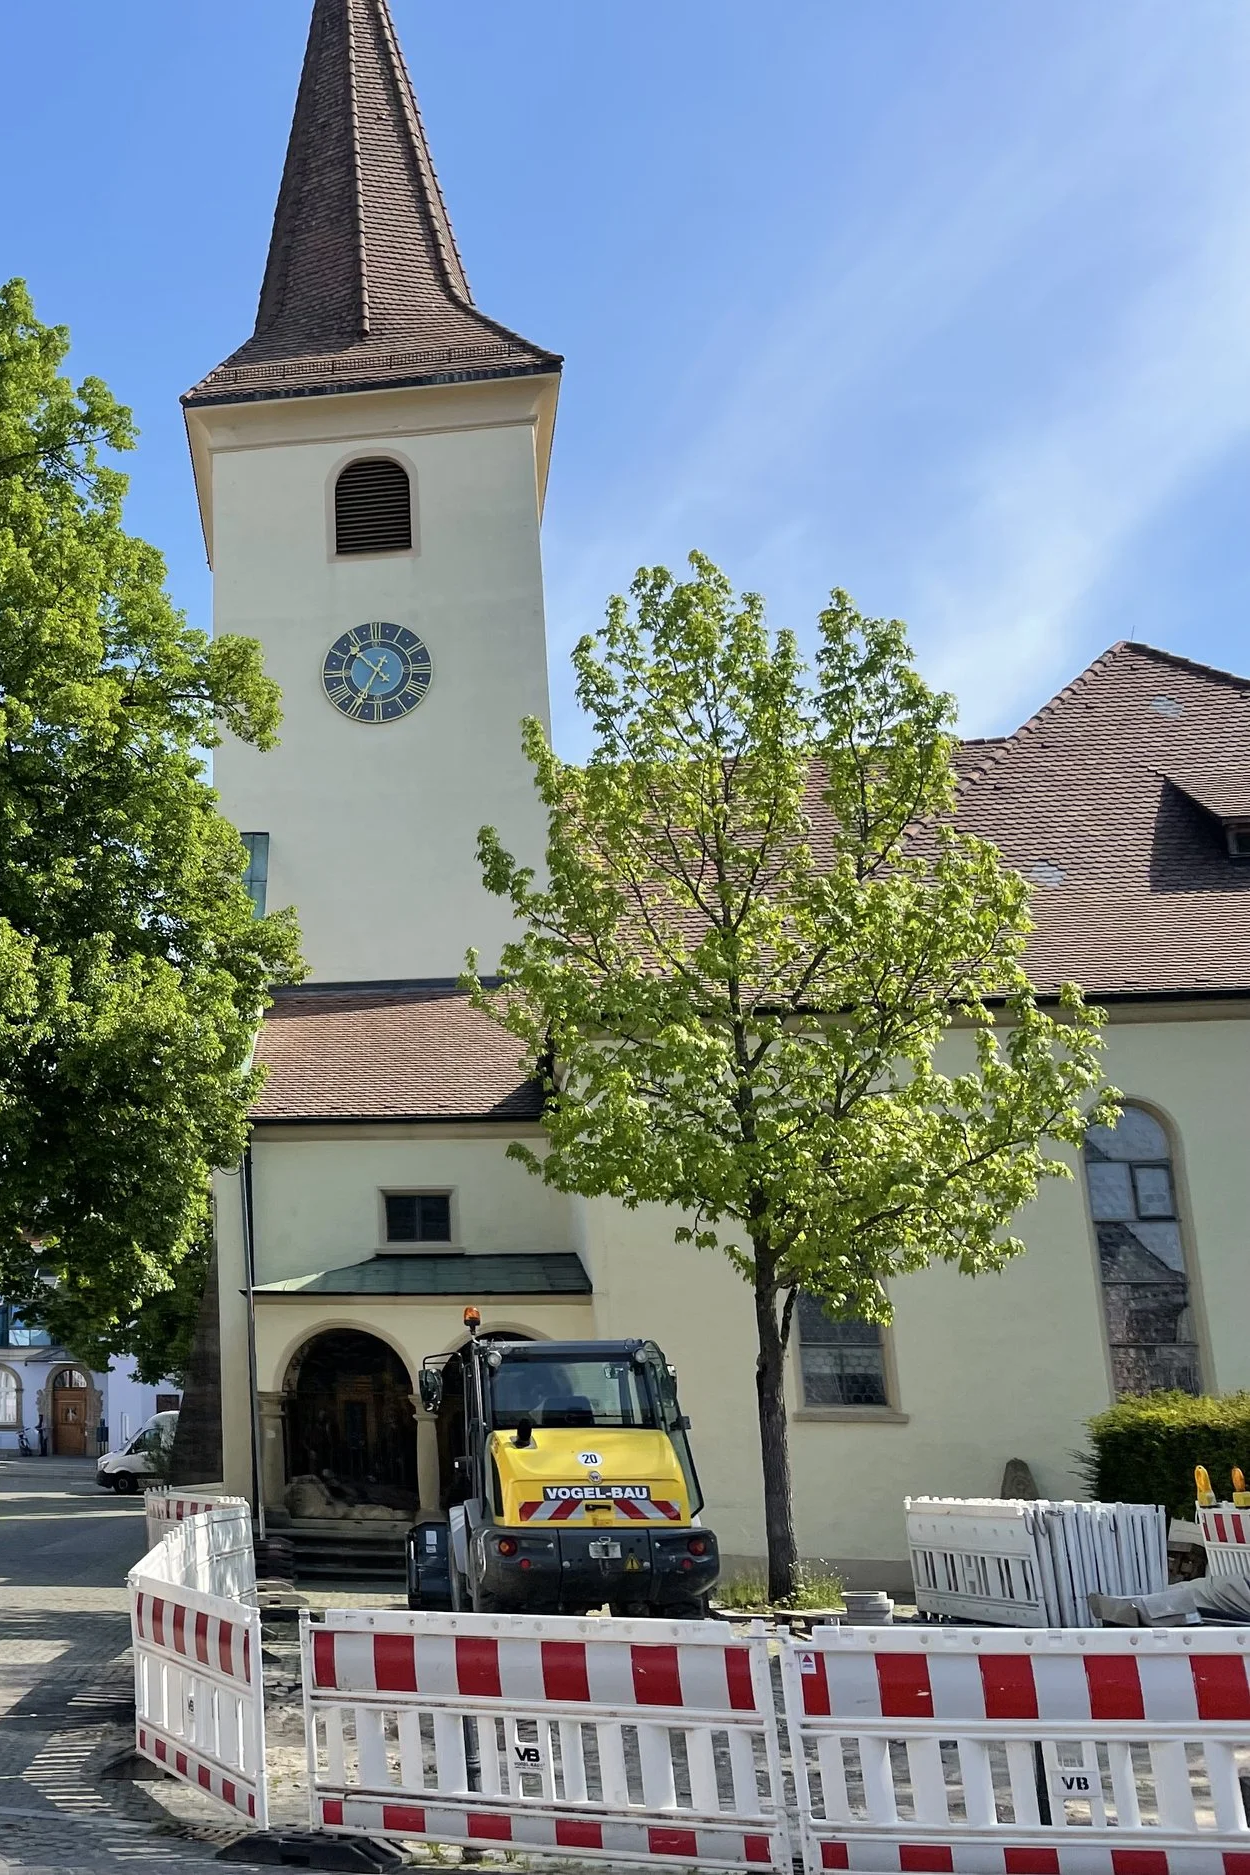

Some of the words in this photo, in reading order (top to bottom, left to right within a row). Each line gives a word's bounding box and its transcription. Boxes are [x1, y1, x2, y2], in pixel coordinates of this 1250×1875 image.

[581, 1454, 598, 1464] 20
[546, 1487, 648, 1499] VOGEL-BAU
[514, 1746, 540, 1762] VB
[1061, 1776, 1090, 1790] VB
